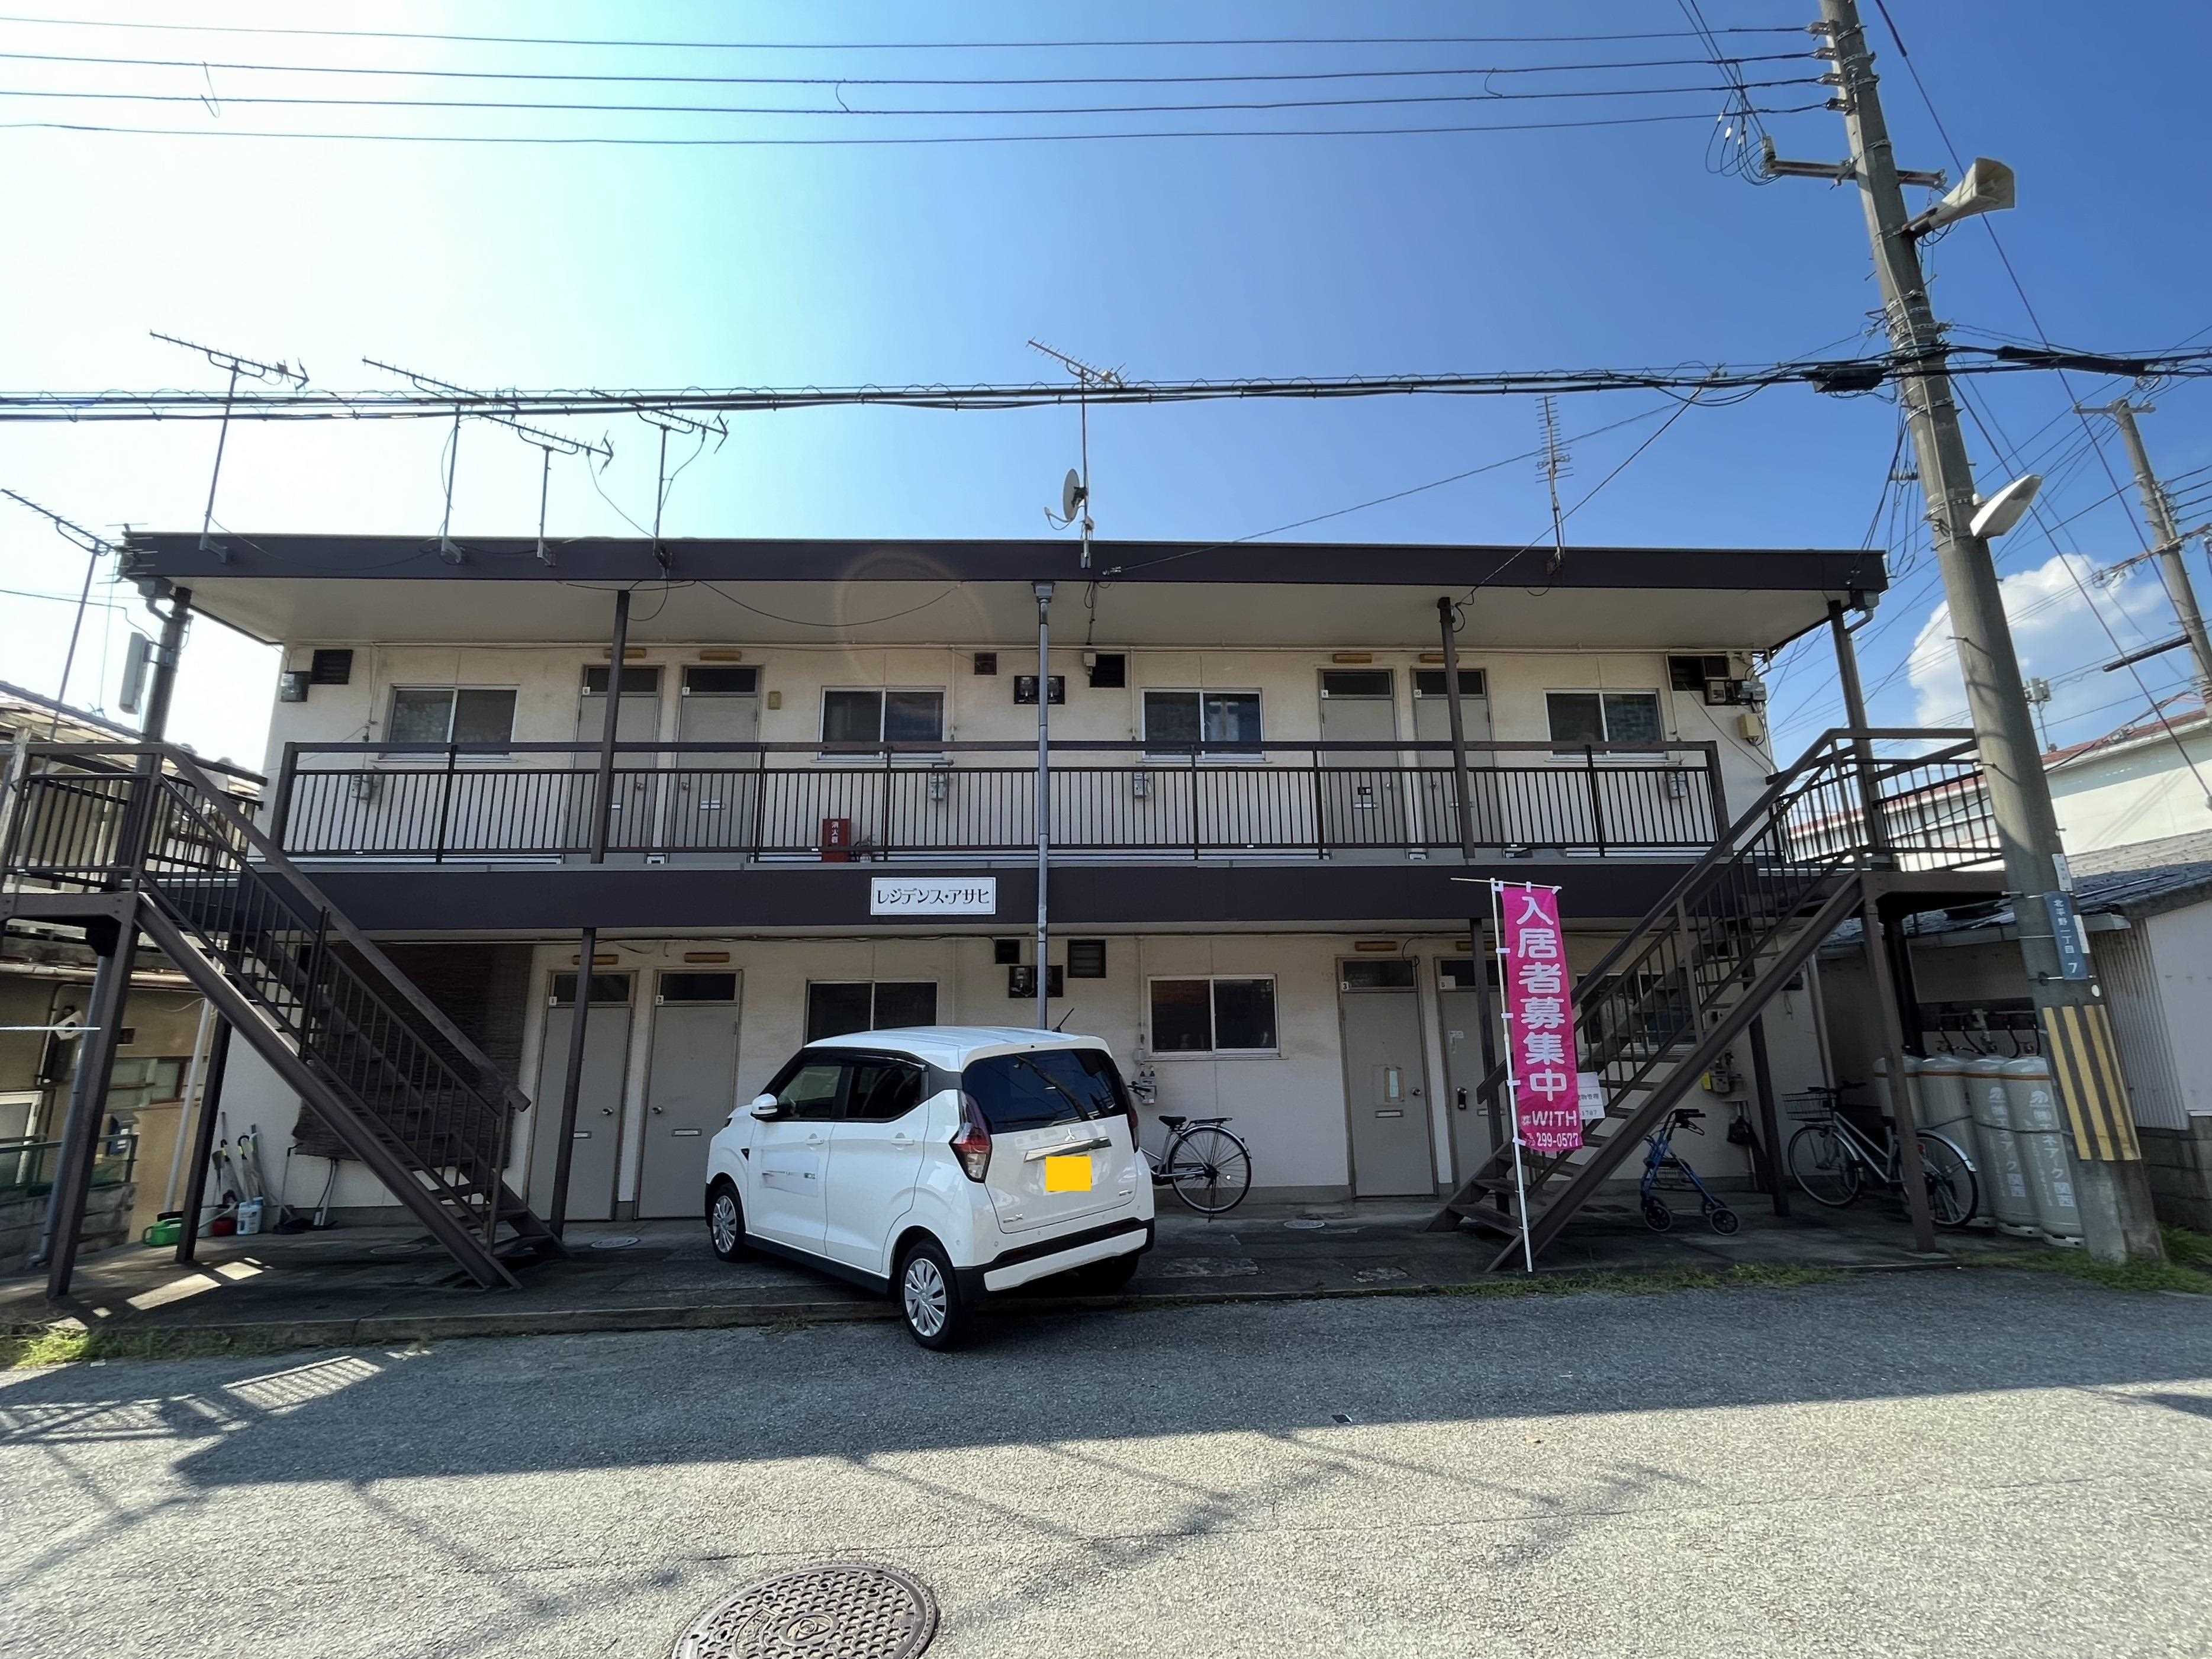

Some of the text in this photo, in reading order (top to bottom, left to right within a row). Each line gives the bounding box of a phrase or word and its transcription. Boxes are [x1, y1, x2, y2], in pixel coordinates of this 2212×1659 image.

[877, 888, 990, 904] レジデンス・アサヒ
[2068, 962, 2078, 974] 7
[1516, 896, 1567, 1101] 入居者募集中
